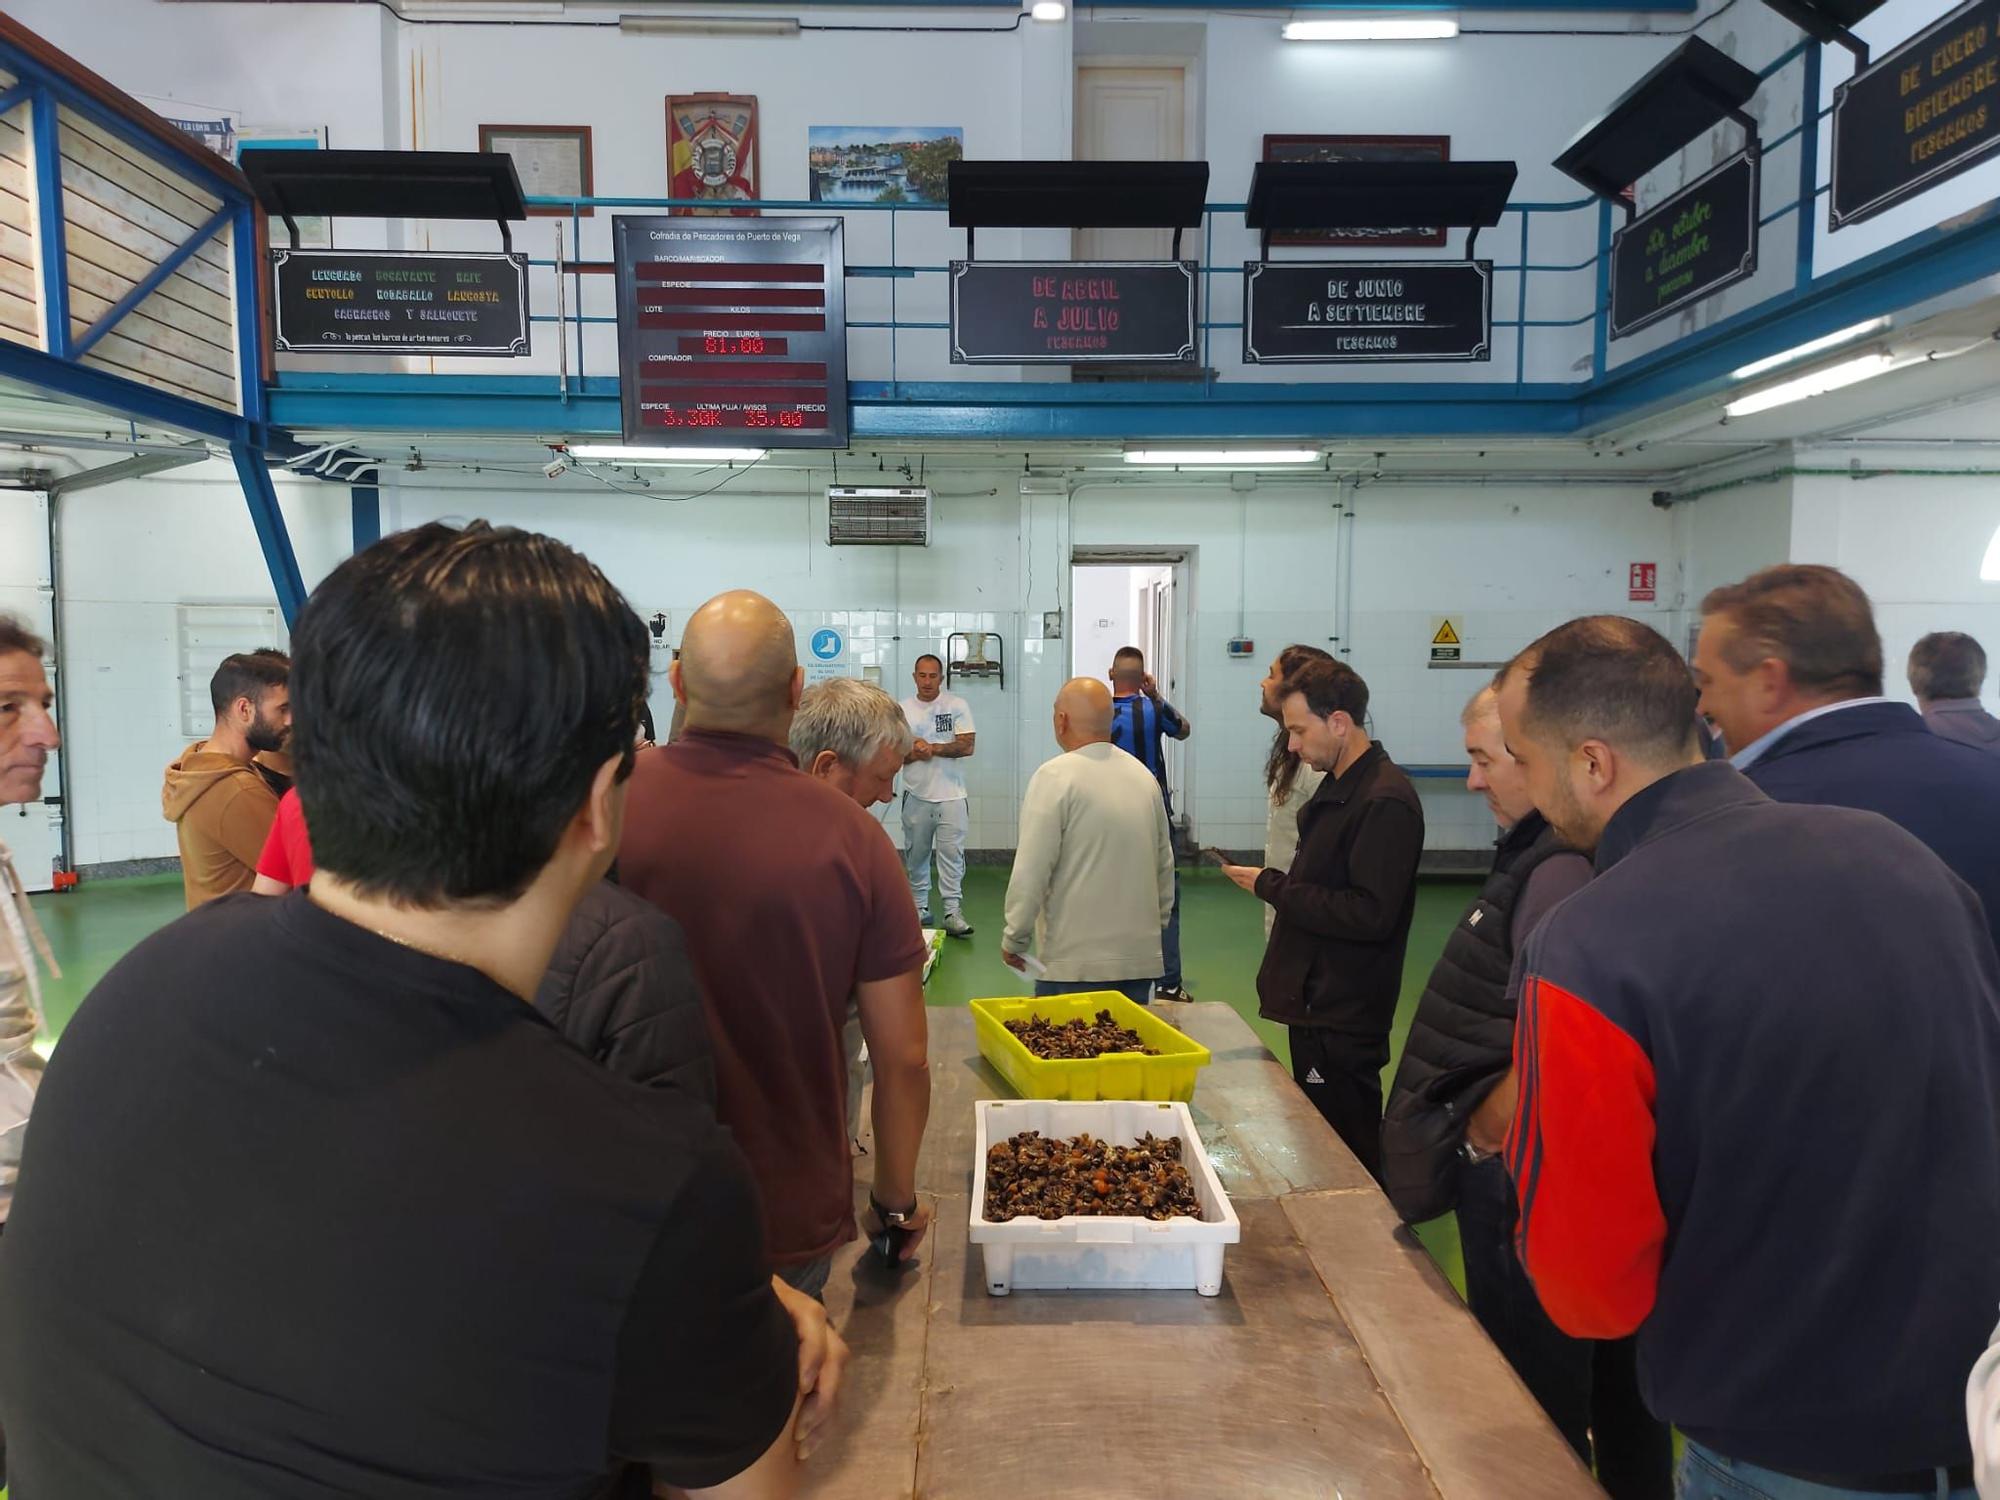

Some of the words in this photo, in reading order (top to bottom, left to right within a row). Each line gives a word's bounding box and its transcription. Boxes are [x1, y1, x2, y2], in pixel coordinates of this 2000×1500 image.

[1901, 63, 1921, 96] DE
[1931, 23, 1985, 76] ENERO
[1904, 59, 1998, 134] DICIEMBRE
[1911, 104, 1986, 164] PESCAMOS
[1672, 201, 1712, 240] octubre
[682, 232, 691, 240] de
[693, 232, 734, 241] Pescadores
[736, 232, 746, 241] de
[747, 232, 770, 241] Puerto
[771, 232, 781, 241] de
[783, 232, 801, 243] Vega
[312, 269, 362, 282] LENGUADO
[376, 270, 437, 283] BOGAVANTE
[306, 287, 354, 300] CENTOLLO
[447, 290, 500, 302] LANGOSTA
[1032, 276, 1056, 298] DE
[1062, 278, 1120, 300] ABRIL
[1327, 280, 1349, 299] DE
[1355, 279, 1404, 298] JUNIO
[334, 308, 391, 321] CABRACHOS
[406, 308, 413, 320] Y
[420, 309, 479, 322] SALMONETE
[1033, 306, 1049, 329] A
[1057, 306, 1120, 331] JULIO
[1307, 302, 1321, 321] A
[1326, 304, 1426, 322] SEPTIEMBRE
[1046, 335, 1109, 350] PESCAMOS
[1336, 335, 1398, 350] PESCAMOS
[796, 404, 826, 412] PRECIO
